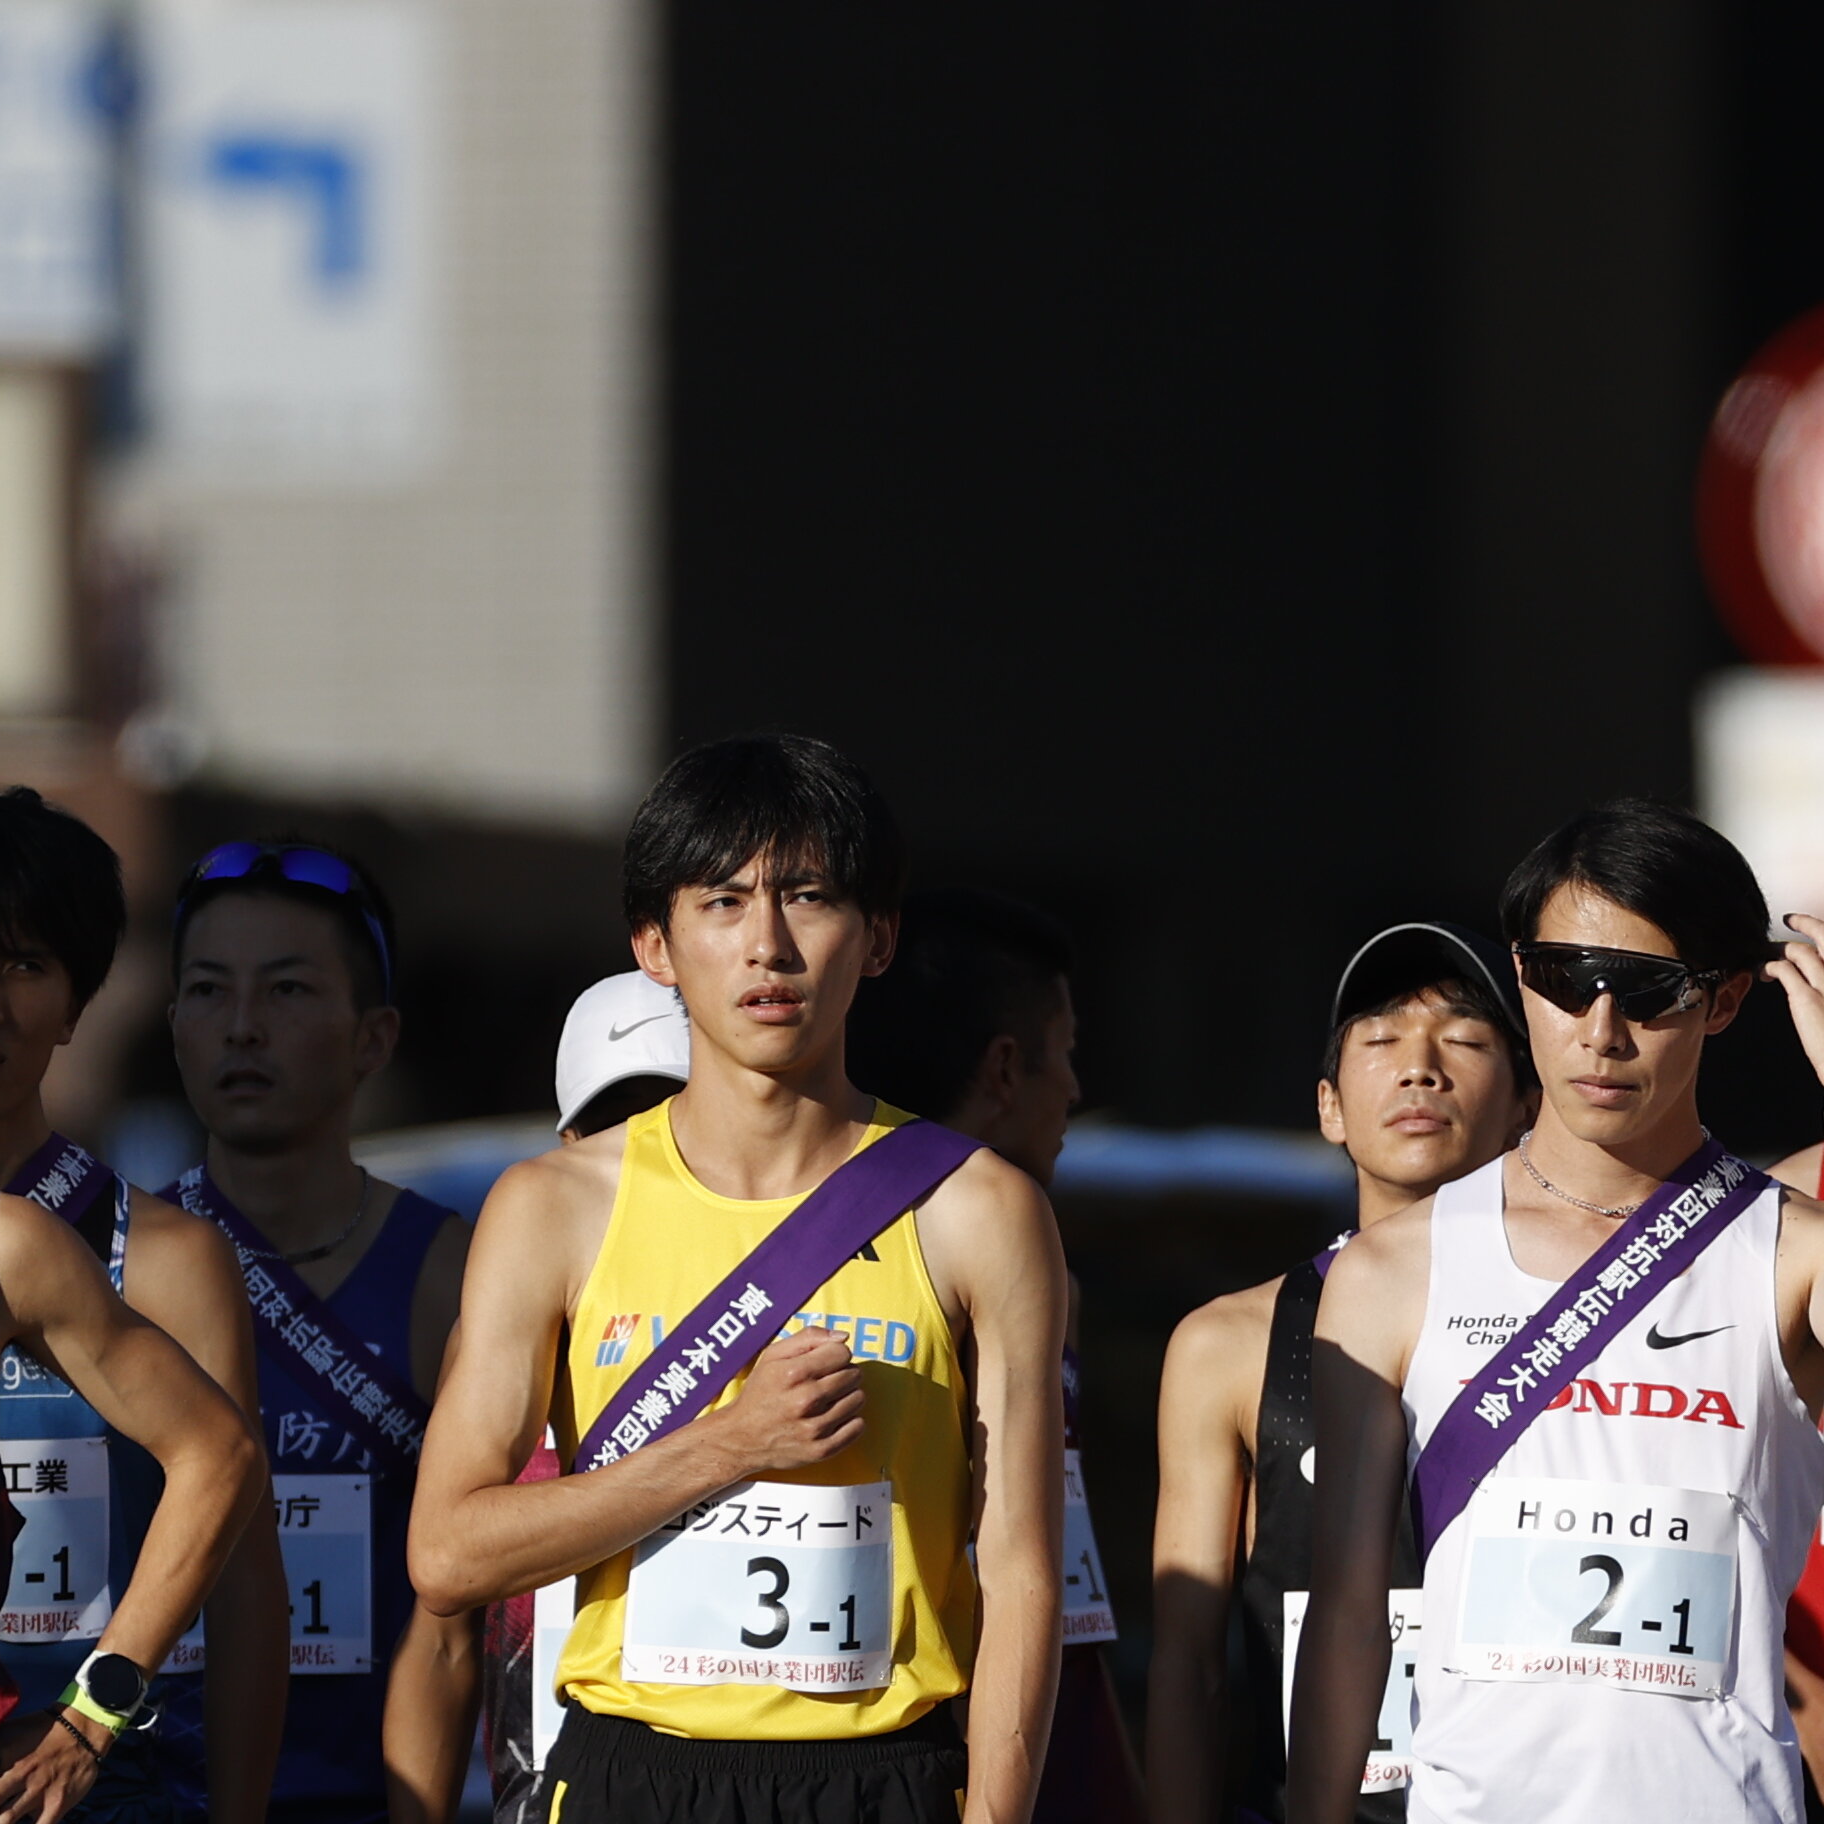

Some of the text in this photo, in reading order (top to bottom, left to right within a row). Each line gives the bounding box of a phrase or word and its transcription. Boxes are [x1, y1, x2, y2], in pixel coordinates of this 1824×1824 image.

[1447, 1314, 1517, 1330] Honda
[1474, 1152, 1751, 1429] 実業団対抗駅伝競走大会
[585, 1283, 773, 1473] 東日本実業団対
[1518, 1501, 1689, 1542] Honda
[740, 1556, 862, 1652] 3-1
[1571, 1554, 1694, 1656] 2-1
[658, 1654, 866, 1683] '24 彩の国実業団駅伝
[1522, 1652, 1697, 1688] 彩の国実業団駅伝
